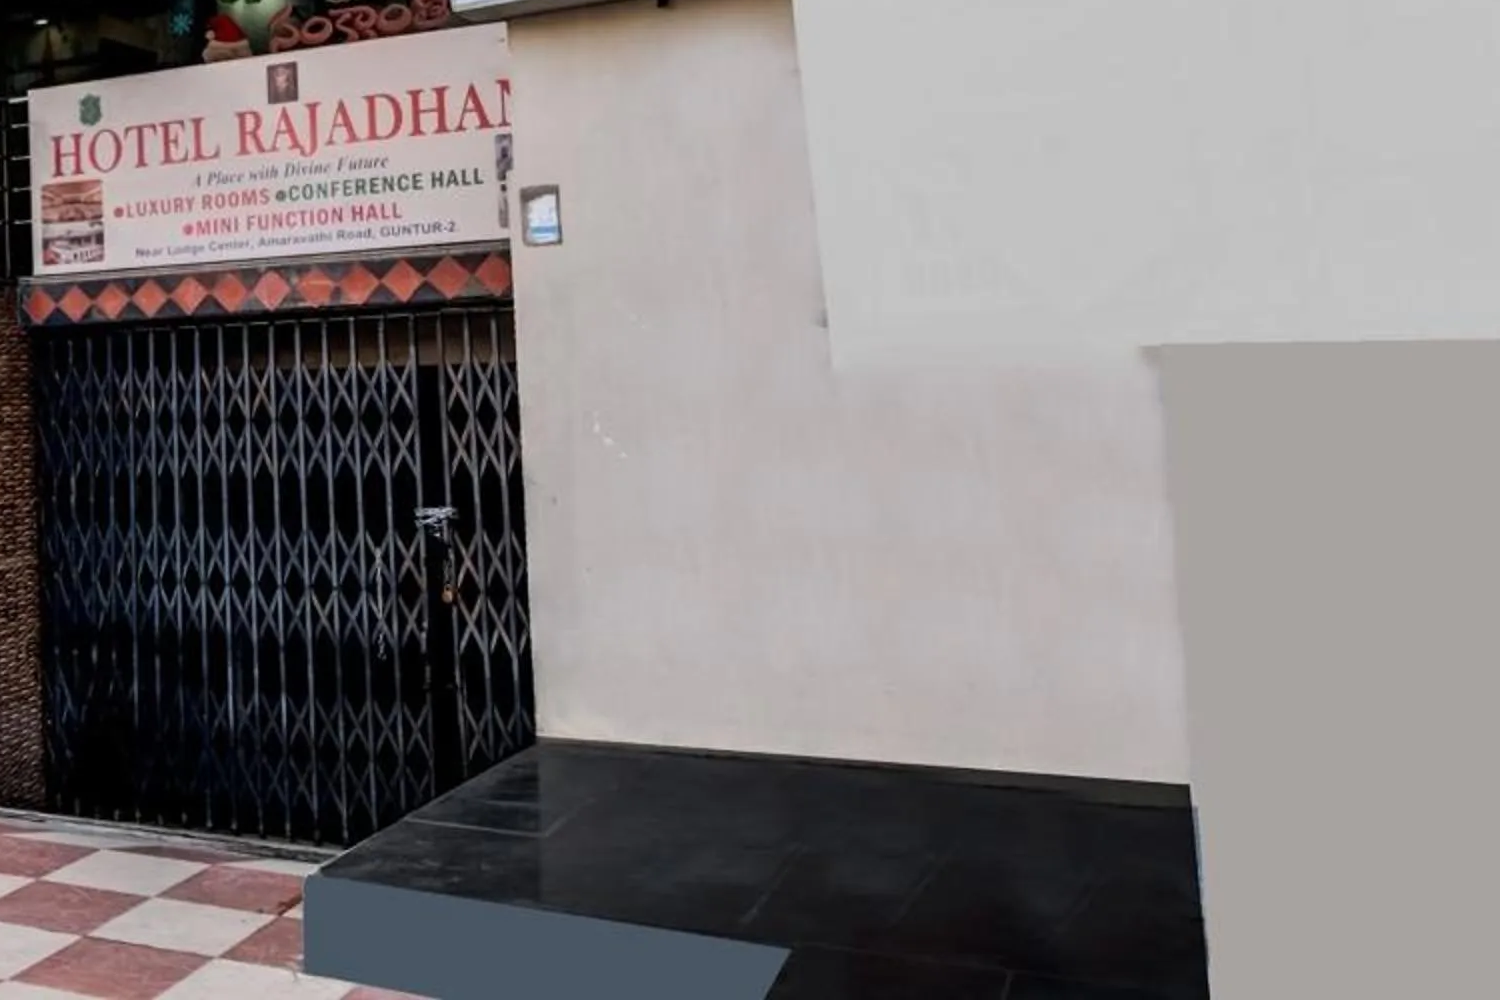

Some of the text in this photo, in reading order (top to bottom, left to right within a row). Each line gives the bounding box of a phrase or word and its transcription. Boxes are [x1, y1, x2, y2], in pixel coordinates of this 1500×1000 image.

[50, 116, 221, 178] HOTEL
[207, 172, 243, 186] Place
[248, 164, 279, 182] with
[284, 161, 331, 178] Divine
[336, 155, 390, 173] Future
[126, 167, 485, 218] LUXURY ROOMS CONFERENCE HALL
[195, 201, 403, 237] MINI FUNCTION HALL
[135, 247, 163, 258] Near
